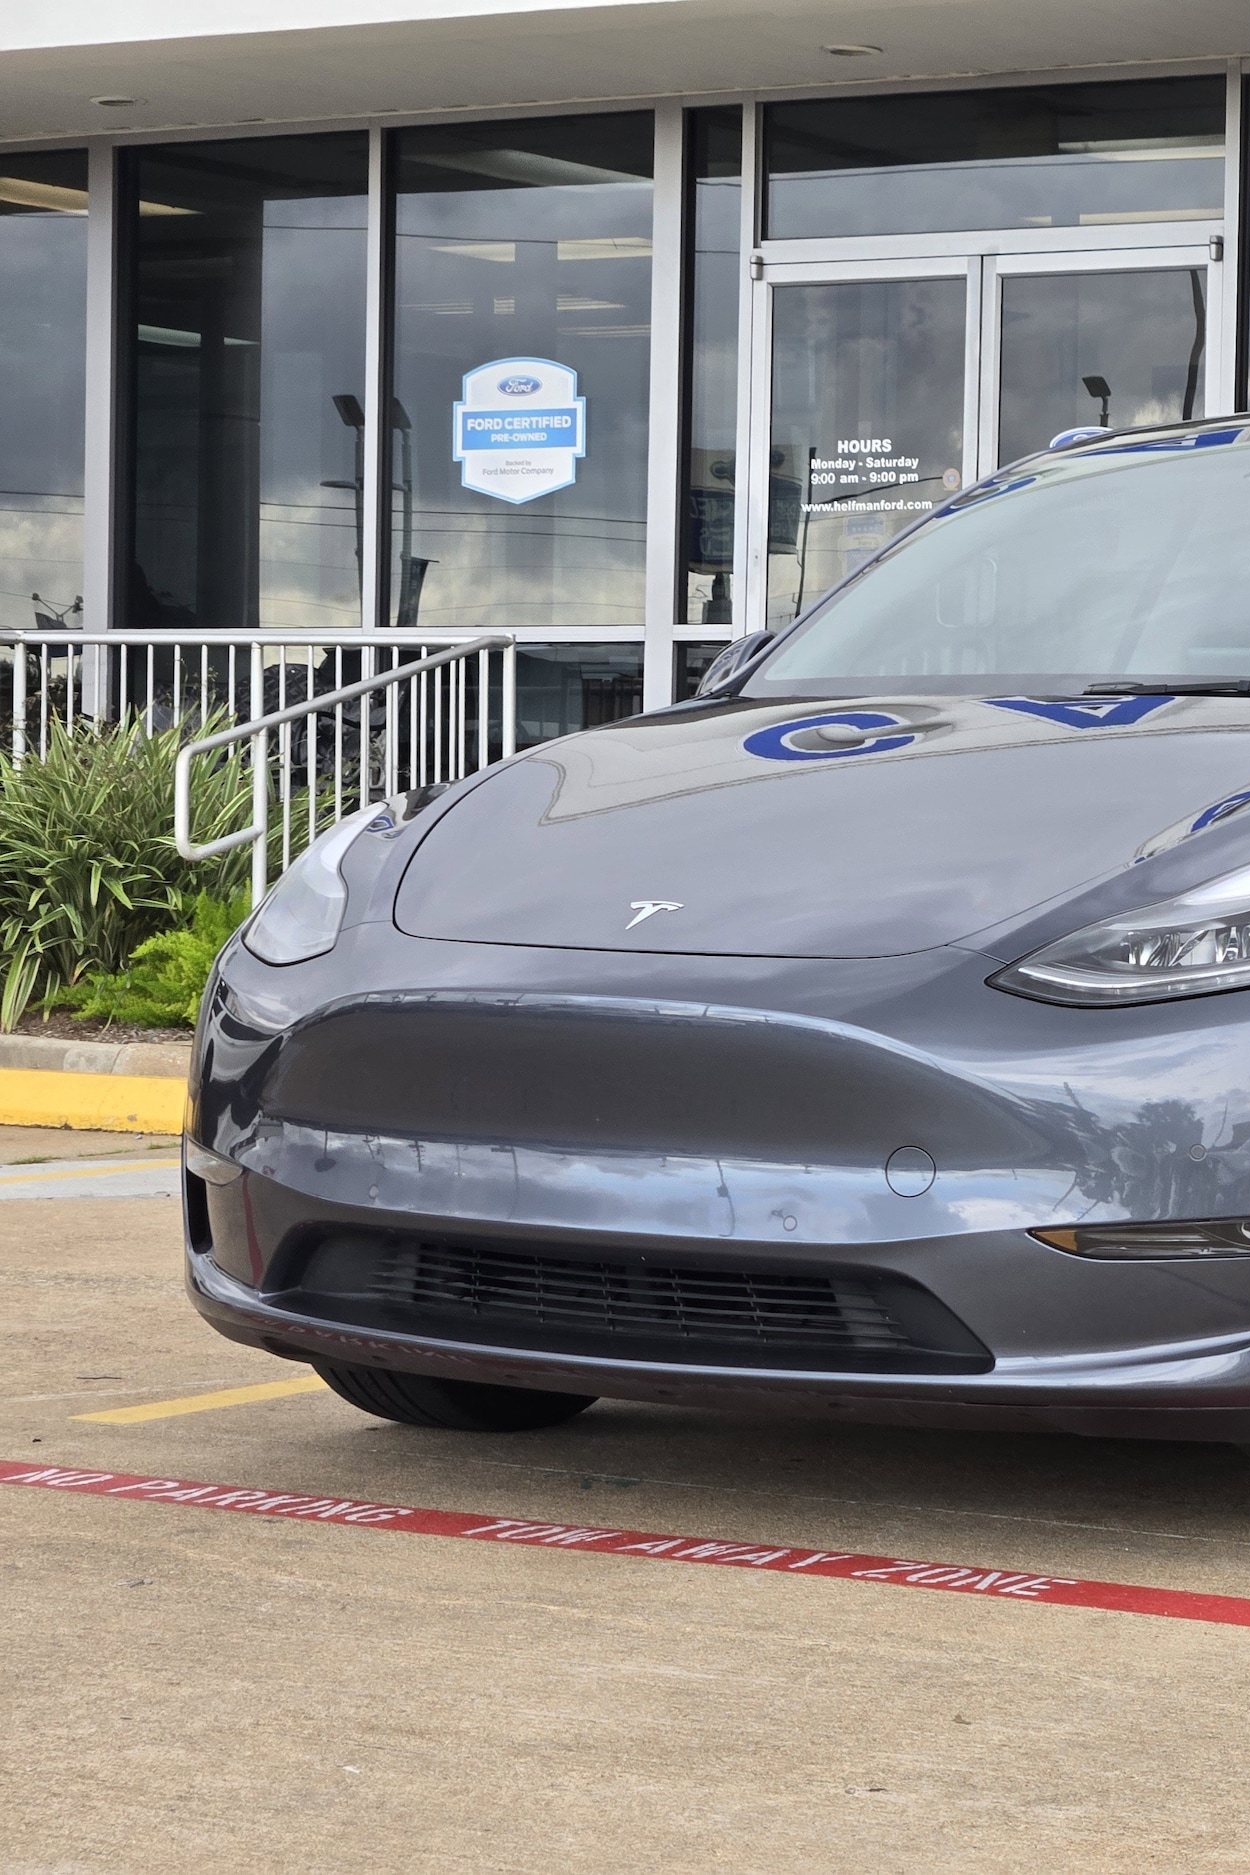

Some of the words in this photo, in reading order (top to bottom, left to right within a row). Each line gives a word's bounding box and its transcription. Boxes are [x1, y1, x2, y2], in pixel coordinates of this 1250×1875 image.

[505, 378, 534, 393] Ford
[467, 418, 502, 431] FORD
[504, 416, 572, 430] CERTIFIED
[491, 432, 547, 442] PRE-OWNED
[837, 439, 892, 453] HOURS
[811, 458, 856, 470] Monday
[865, 456, 919, 469] Saturday
[483, 468, 498, 476] Ford
[500, 467, 520, 475] Motor
[521, 467, 554, 476] Company
[811, 473, 836, 485] 9:00
[839, 474, 859, 483] am
[869, 472, 896, 483] 9:00
[899, 474, 919, 484] pm
[801, 498, 933, 513] www.helfmanford.com
[1, 1468, 113, 1488] NO
[105, 1479, 414, 1523] PARKING
[461, 1519, 622, 1545] TOW
[613, 1538, 853, 1570] AWAY
[849, 1560, 1079, 1597] ZONE
